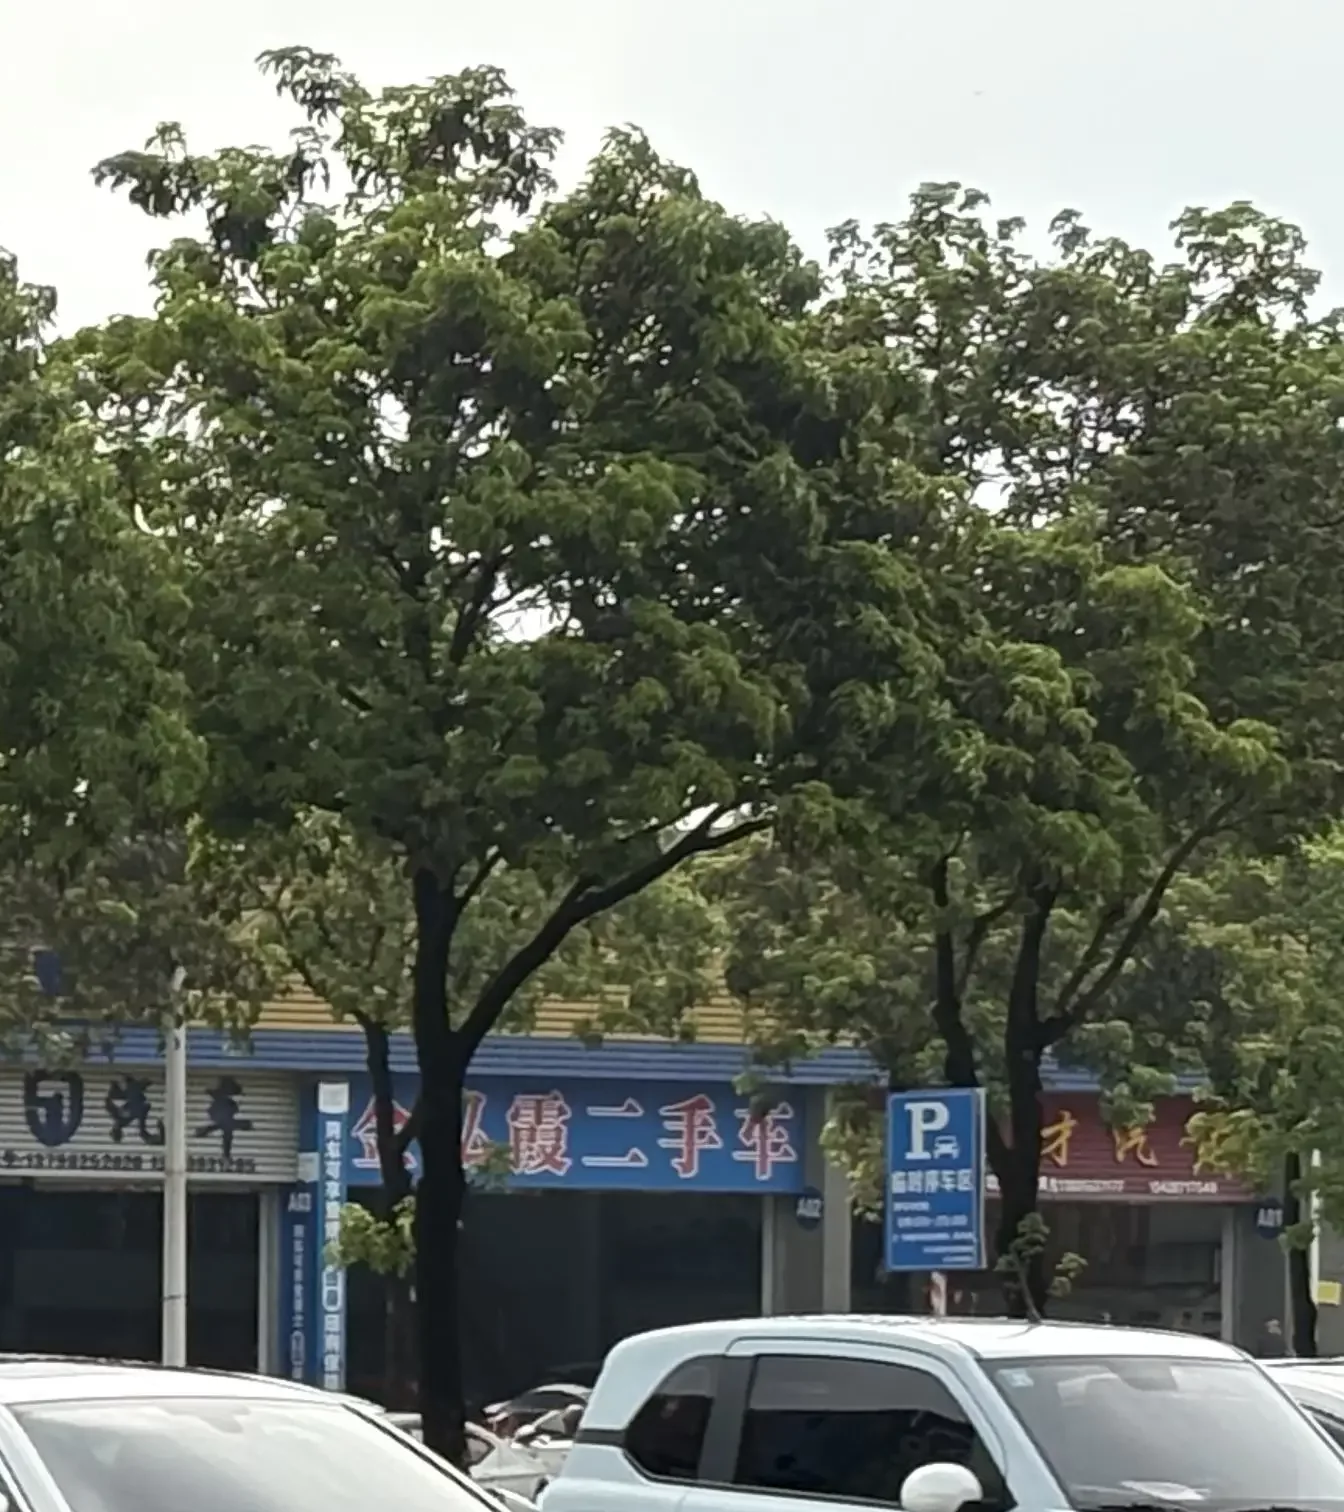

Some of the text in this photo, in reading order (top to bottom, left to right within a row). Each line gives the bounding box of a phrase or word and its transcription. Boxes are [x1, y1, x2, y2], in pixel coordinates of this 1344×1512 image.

[352, 1090, 797, 1180] 金霞二手车
[905, 1102, 949, 1160] P
